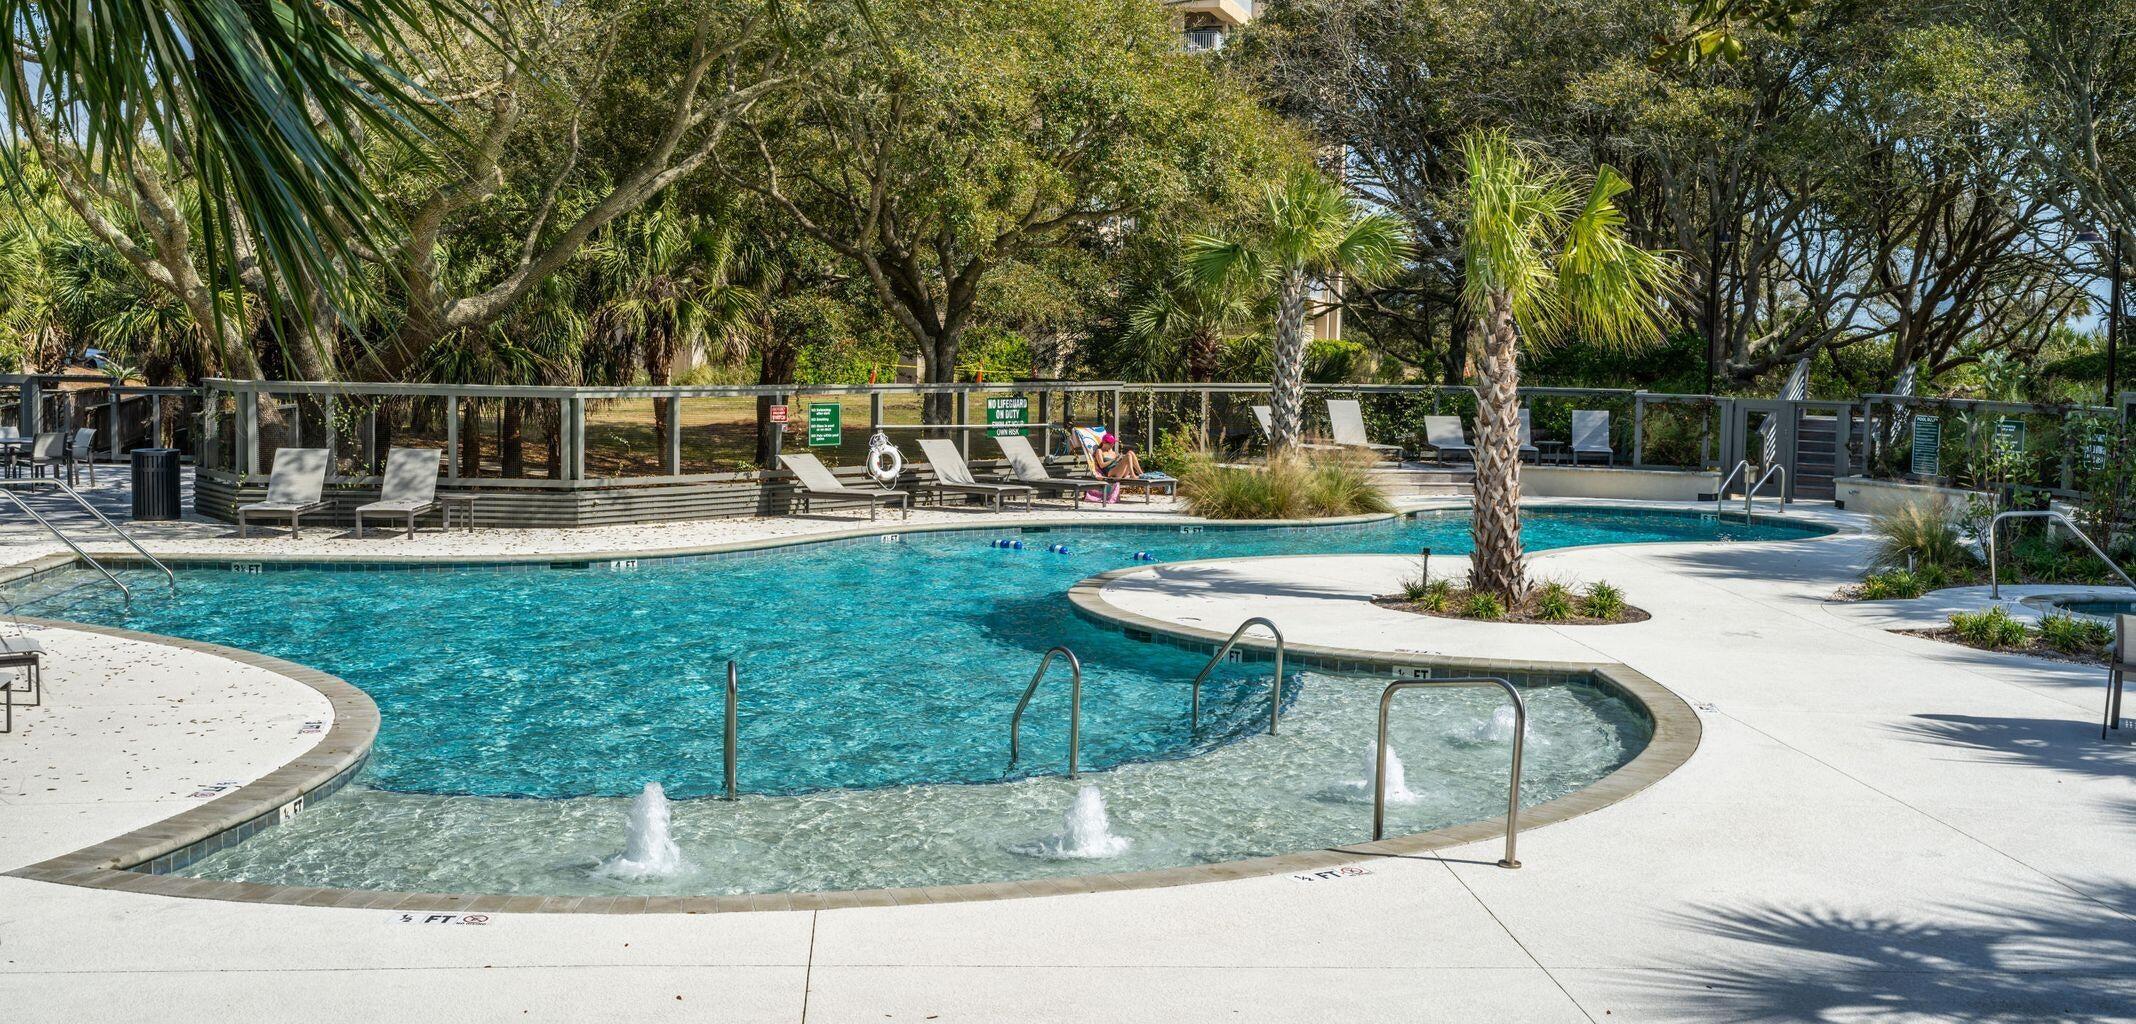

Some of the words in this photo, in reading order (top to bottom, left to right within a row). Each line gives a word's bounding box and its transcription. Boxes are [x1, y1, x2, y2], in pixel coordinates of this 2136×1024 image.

[988, 399, 996, 408] NO
[998, 399, 1027, 408] LIFEGUARD
[996, 410, 1004, 419] ON
[1005, 410, 1020, 418] DUTY
[248, 564, 261, 574] FT
[1230, 651, 1241, 662] FT
[294, 798, 303, 815] FT
[1314, 870, 1341, 879] FT
[424, 914, 457, 924] FT
